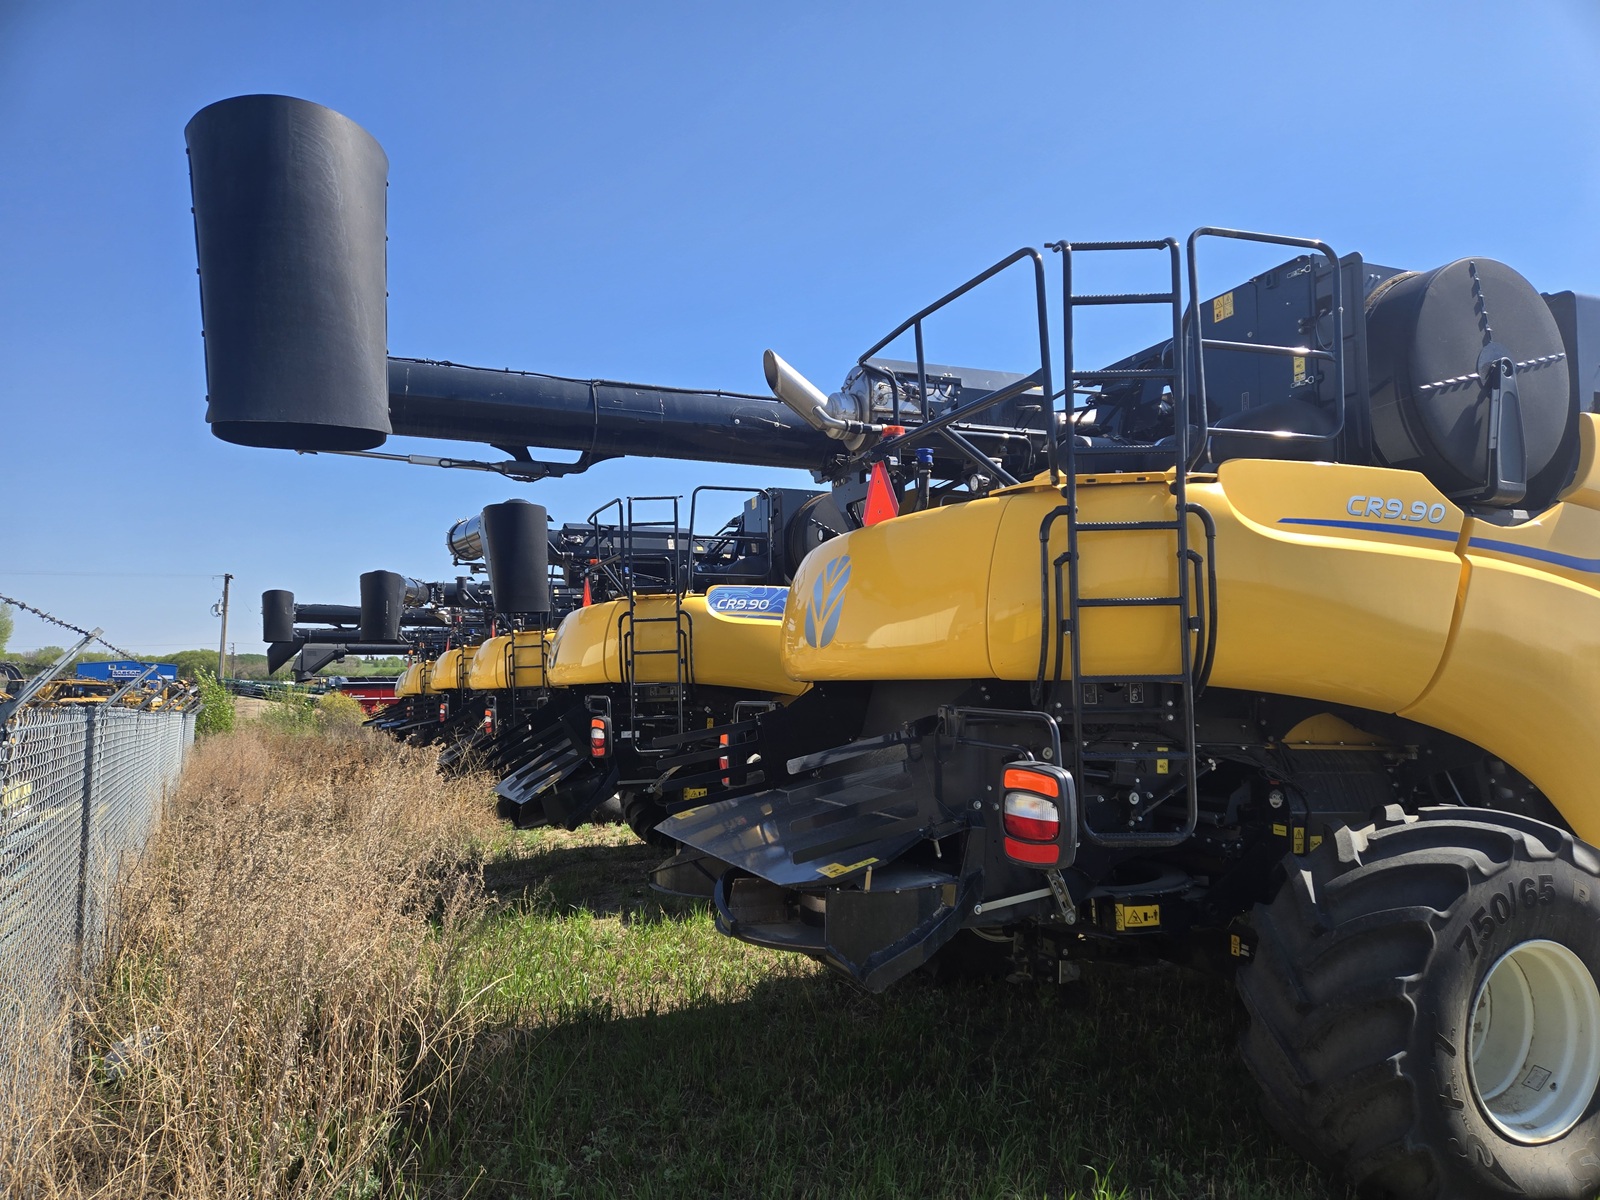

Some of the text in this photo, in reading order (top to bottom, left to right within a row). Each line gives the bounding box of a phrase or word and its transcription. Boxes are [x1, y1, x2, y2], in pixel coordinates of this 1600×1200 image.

[1347, 495, 1446, 523] CR9.90
[716, 599, 770, 610] CR9.90
[1453, 874, 1556, 960] 750/65
